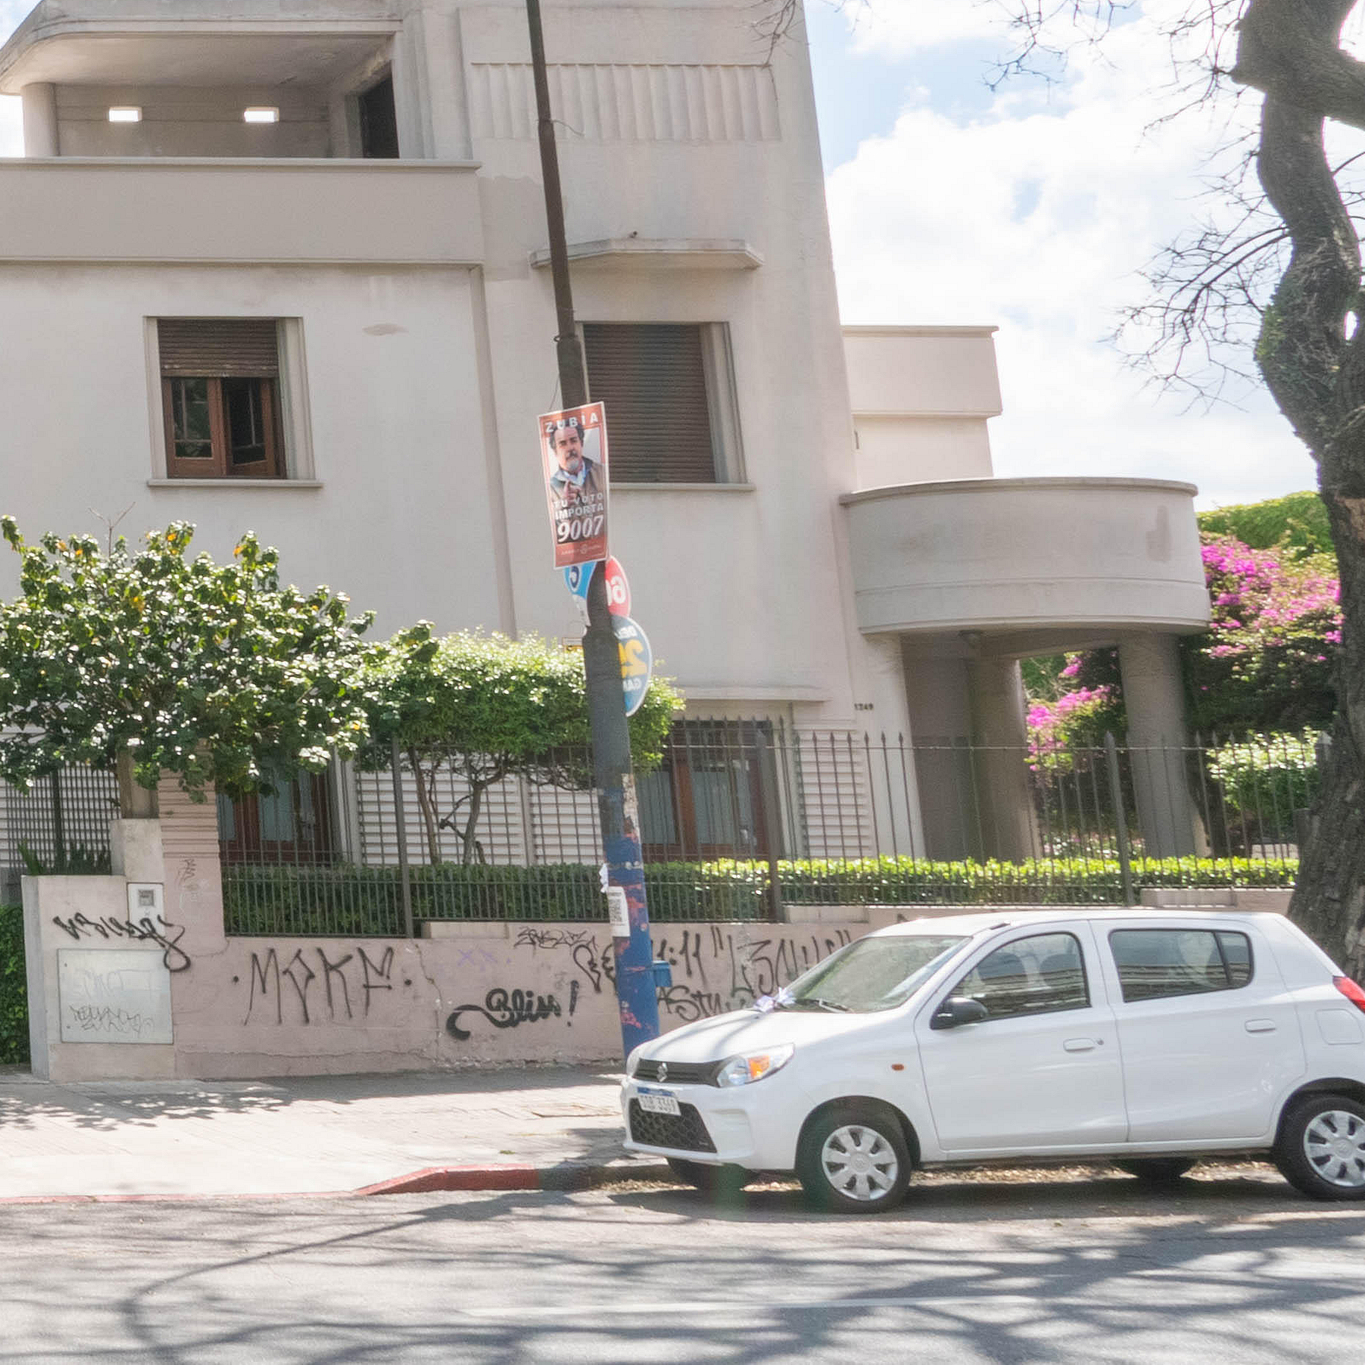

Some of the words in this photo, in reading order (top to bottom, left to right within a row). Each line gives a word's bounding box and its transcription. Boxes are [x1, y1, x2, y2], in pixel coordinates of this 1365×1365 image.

[545, 412, 599, 433] ZUBIA
[554, 500, 568, 509] TU
[574, 493, 603, 505] VOTO
[555, 503, 604, 520] IMPORTA
[557, 515, 604, 542] 9007
